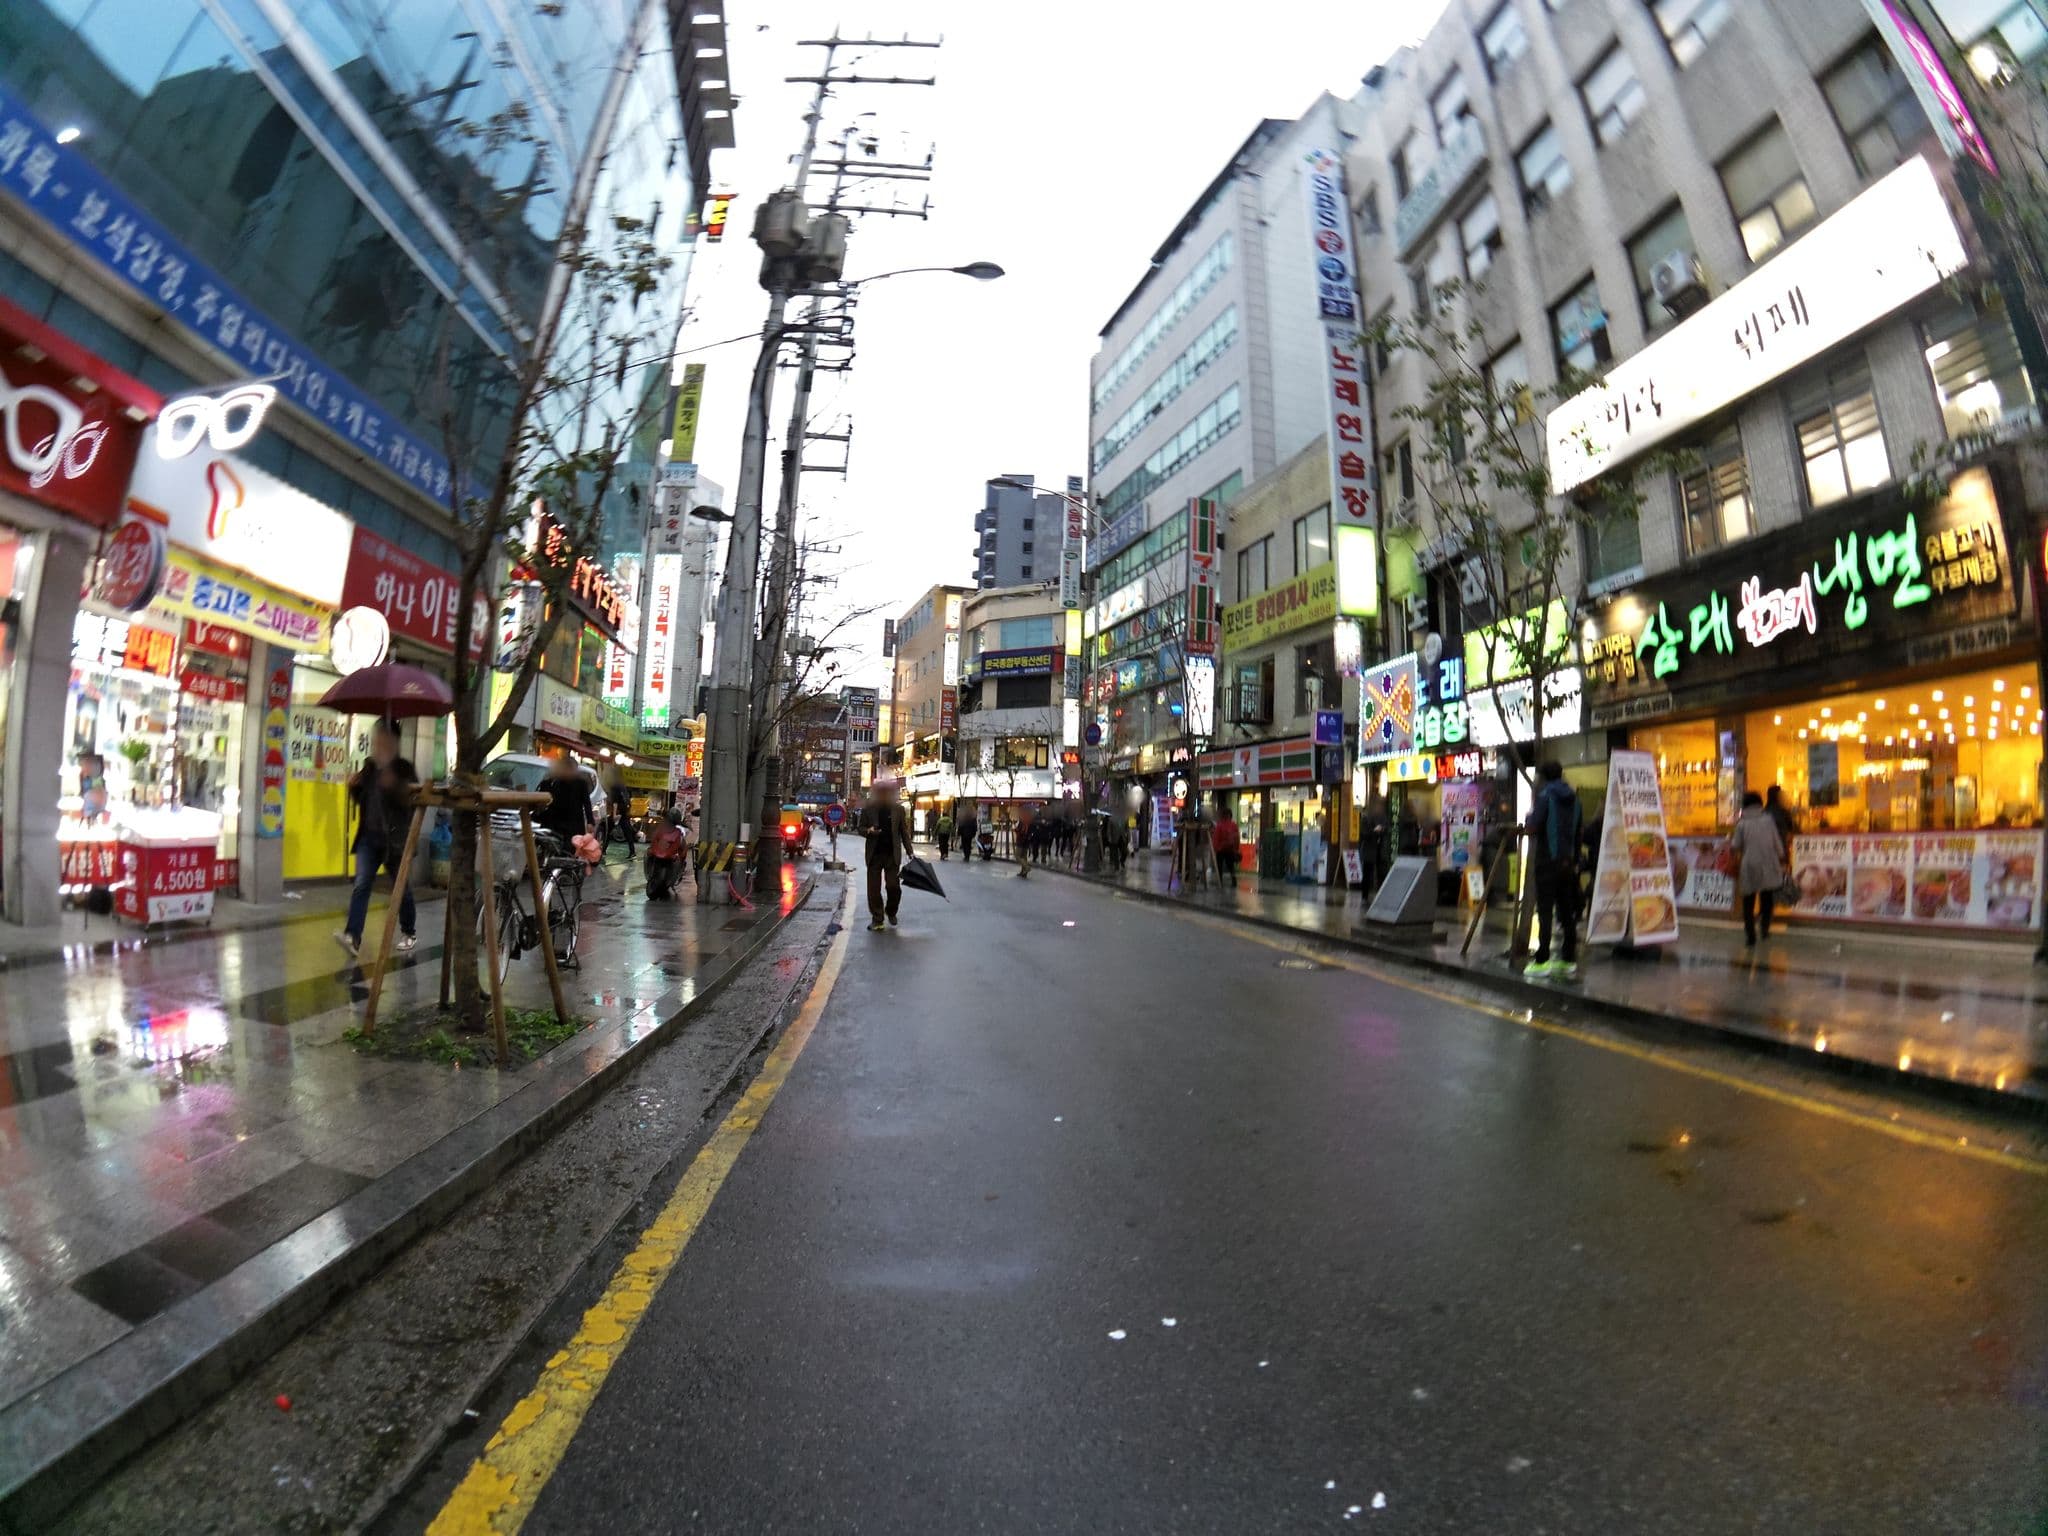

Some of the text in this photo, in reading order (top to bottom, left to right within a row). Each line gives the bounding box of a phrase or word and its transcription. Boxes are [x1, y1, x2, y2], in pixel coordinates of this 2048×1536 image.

[1331, 344, 1370, 518] 노래연습장
[1312, 575, 1336, 599] 사무소
[1635, 589, 1733, 679] 삼대
[1814, 512, 1931, 630] 냉면
[1931, 551, 1997, 595] 무료제공
[192, 576, 252, 621] 중고폰
[253, 600, 321, 643] 스마트폰
[375, 571, 416, 626] 하나
[294, 714, 314, 735] 이발
[154, 869, 206, 893] 4,500원
